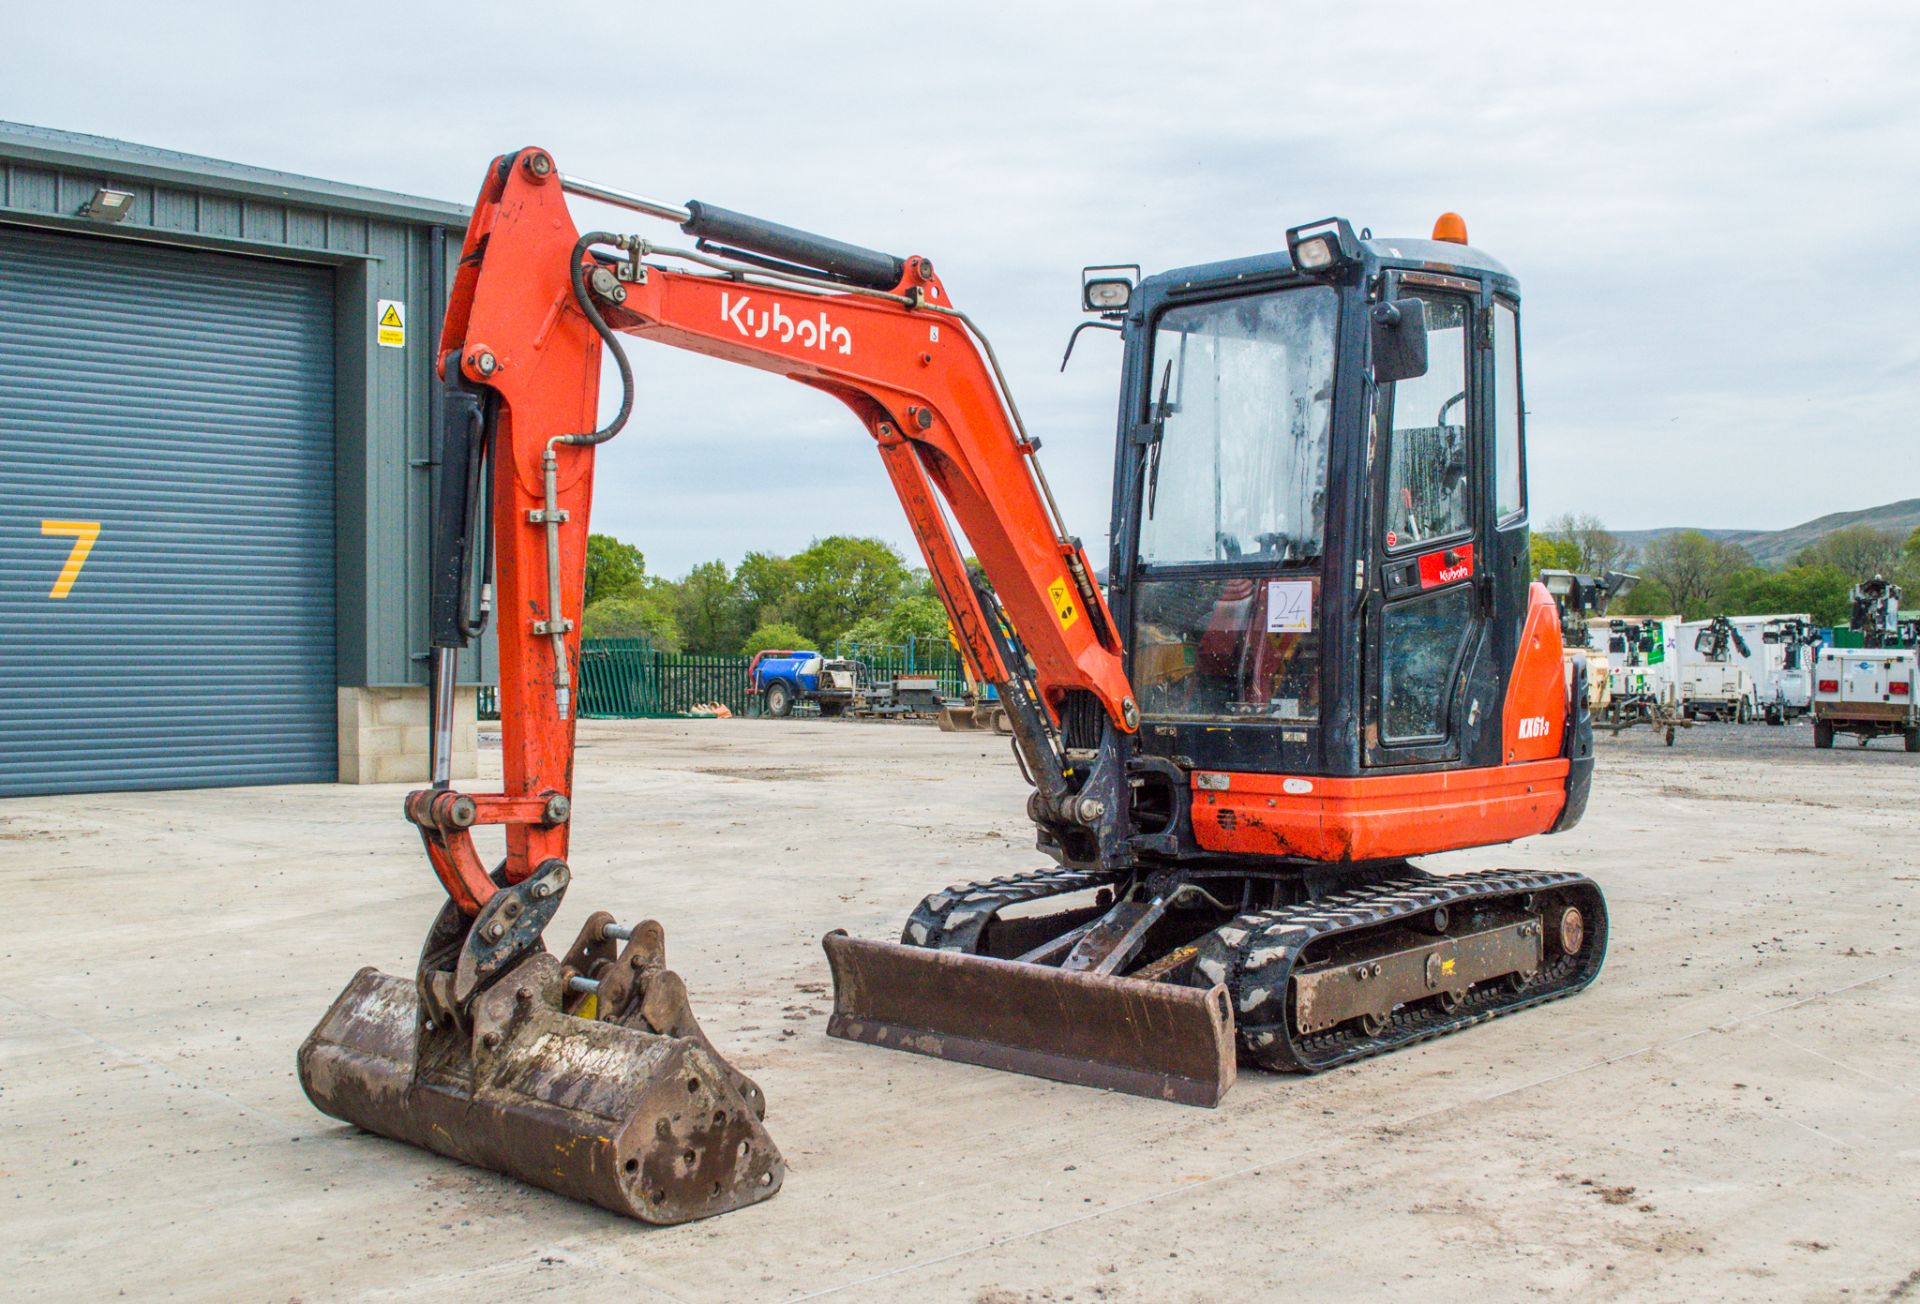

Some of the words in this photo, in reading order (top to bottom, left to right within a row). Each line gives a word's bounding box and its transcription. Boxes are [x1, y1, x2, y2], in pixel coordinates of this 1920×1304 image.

[721, 292, 851, 355] Kubota
[41, 520, 100, 598] 7
[1440, 566, 1468, 581] Kubota
[1274, 591, 1304, 619] 24
[1518, 716, 1550, 740] KX61-3
